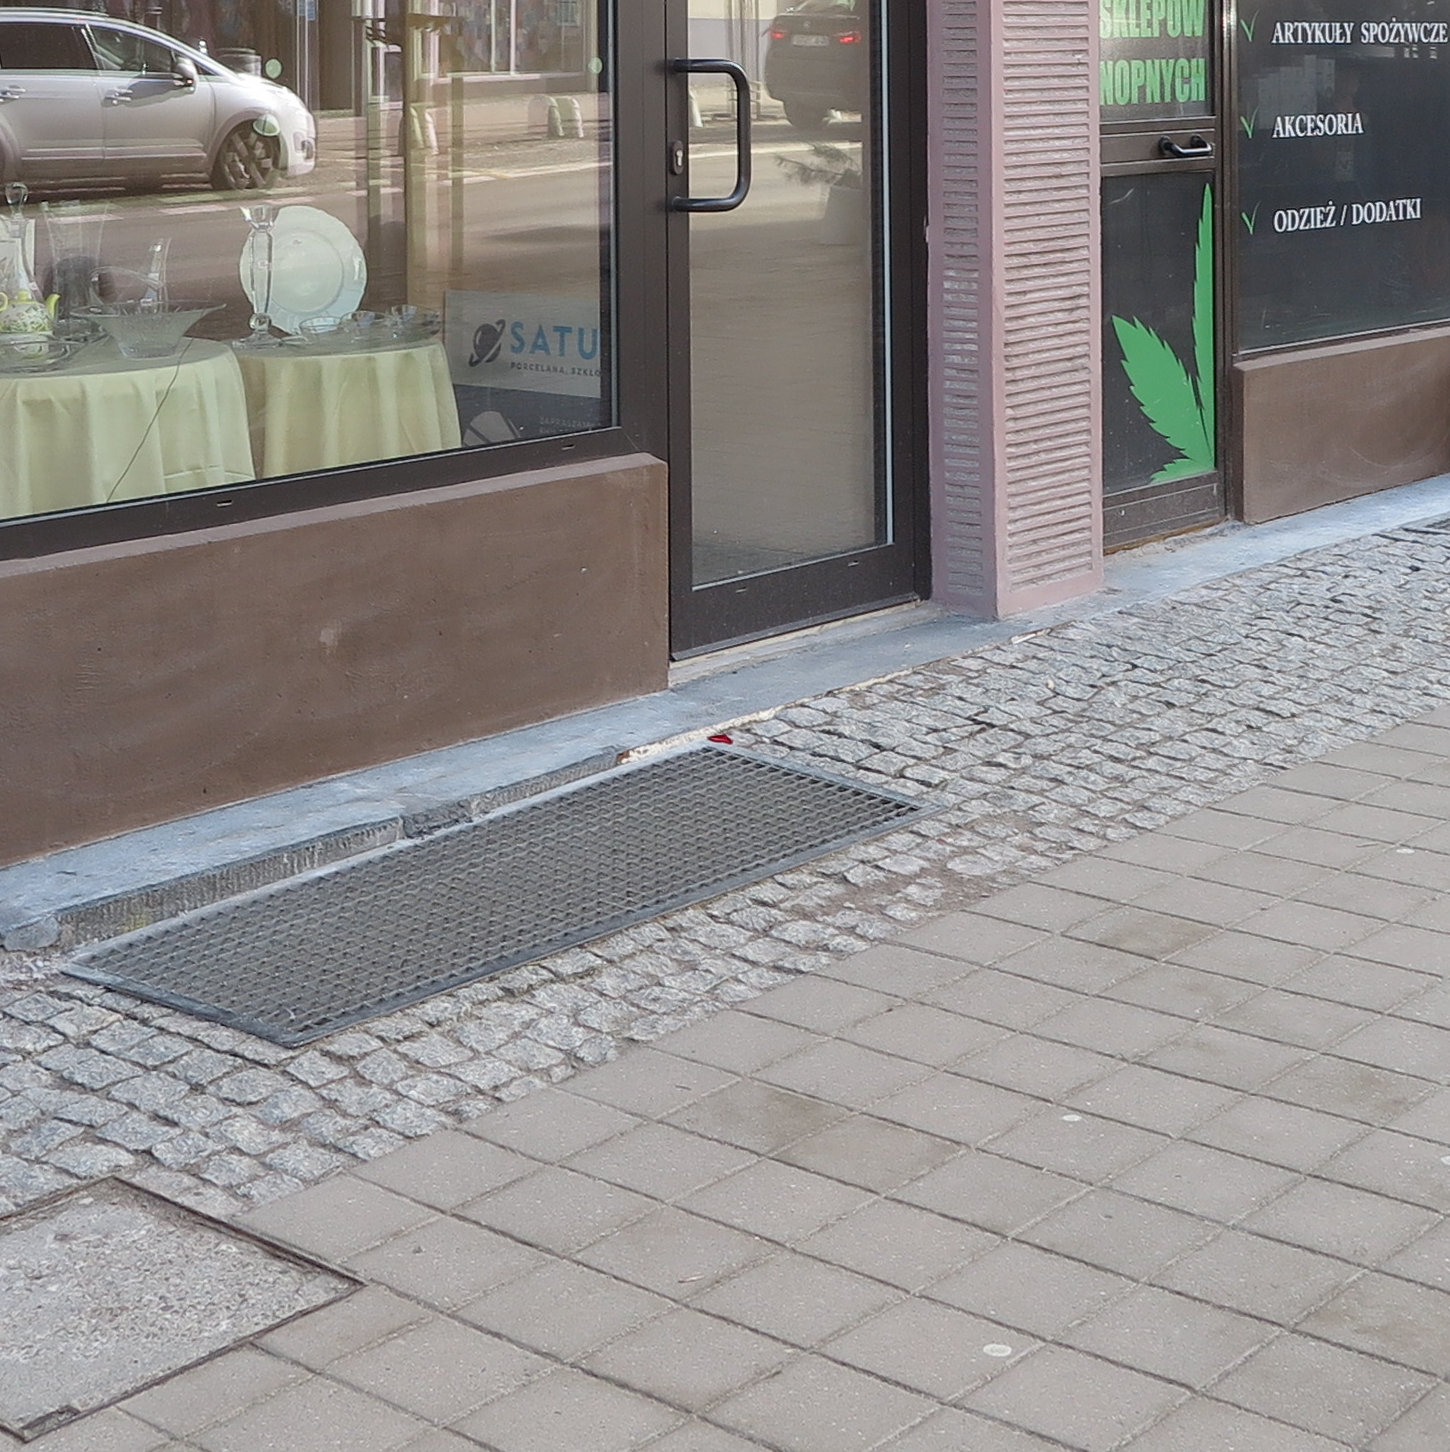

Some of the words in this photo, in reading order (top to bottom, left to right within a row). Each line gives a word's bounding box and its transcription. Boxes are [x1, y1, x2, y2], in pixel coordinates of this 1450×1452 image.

[1271, 21, 1355, 45] ARTYKUŁY
[1360, 17, 1449, 44] SPOŻYWCZE
[1099, 58, 1207, 107] NOPNYCH
[1271, 113, 1365, 139] AKCESORIA
[1273, 200, 1337, 233] ODZIEŻ
[1350, 198, 1423, 226] DODATKI
[509, 321, 601, 361] SATU
